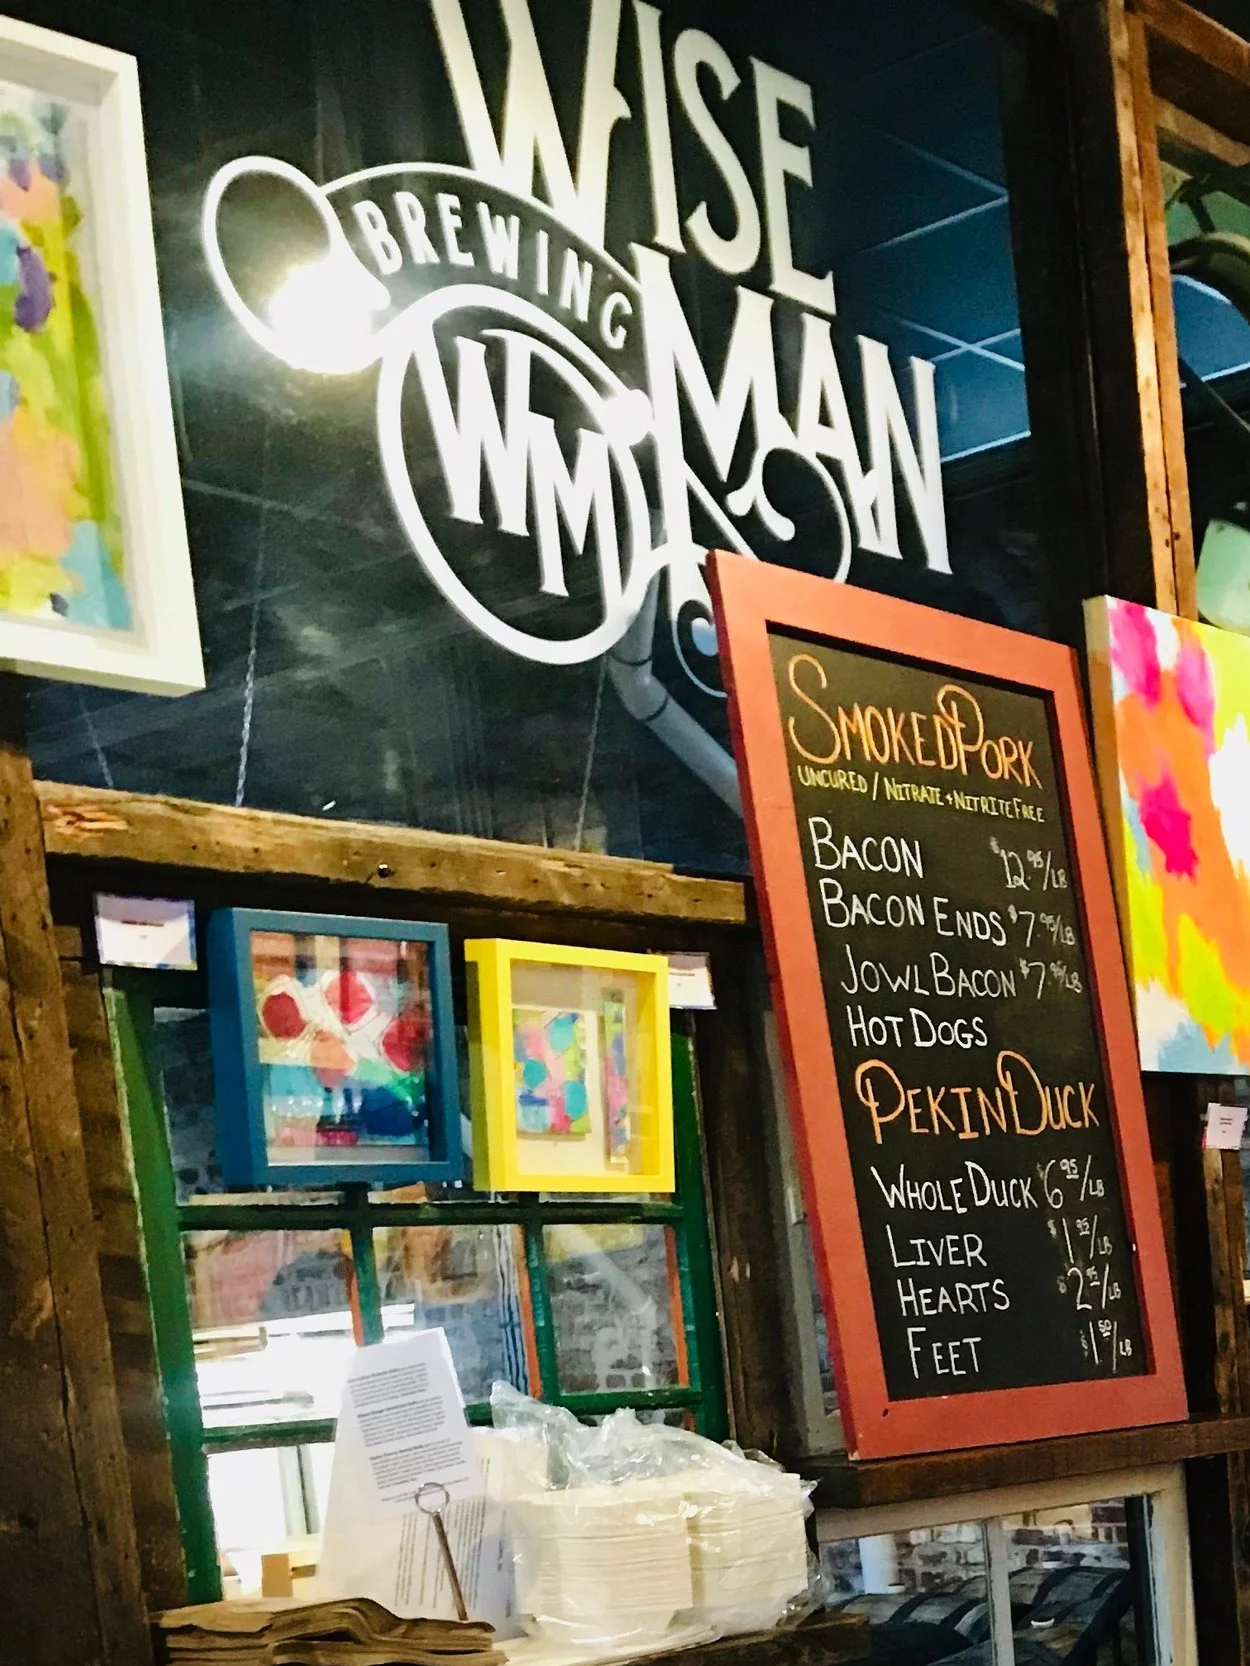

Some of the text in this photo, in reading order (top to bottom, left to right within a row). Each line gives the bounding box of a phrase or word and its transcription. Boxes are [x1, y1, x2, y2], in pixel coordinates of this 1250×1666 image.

[431, 0, 837, 314] WISE
[351, 190, 635, 350] BREWING
[631, 241, 953, 602] MAN
[788, 653, 1043, 789] SMOKED PORK
[797, 765, 868, 793] UNCURED
[884, 777, 944, 805] NITRATE
[809, 816, 924, 879] BACON
[818, 877, 925, 929] BACON
[934, 896, 1007, 947] ENDS
[841, 945, 930, 997] JOWL
[930, 952, 1016, 999] BACON
[846, 1005, 988, 1049] HOT DOGS
[854, 1050, 1100, 1144] PEKIN DUCK
[870, 1164, 967, 1215] WHOLE
[964, 1160, 1039, 1210] DUCK
[886, 1224, 988, 1269] LIVER
[896, 1277, 1011, 1317] HEARTS
[907, 1326, 983, 1380] FEET
